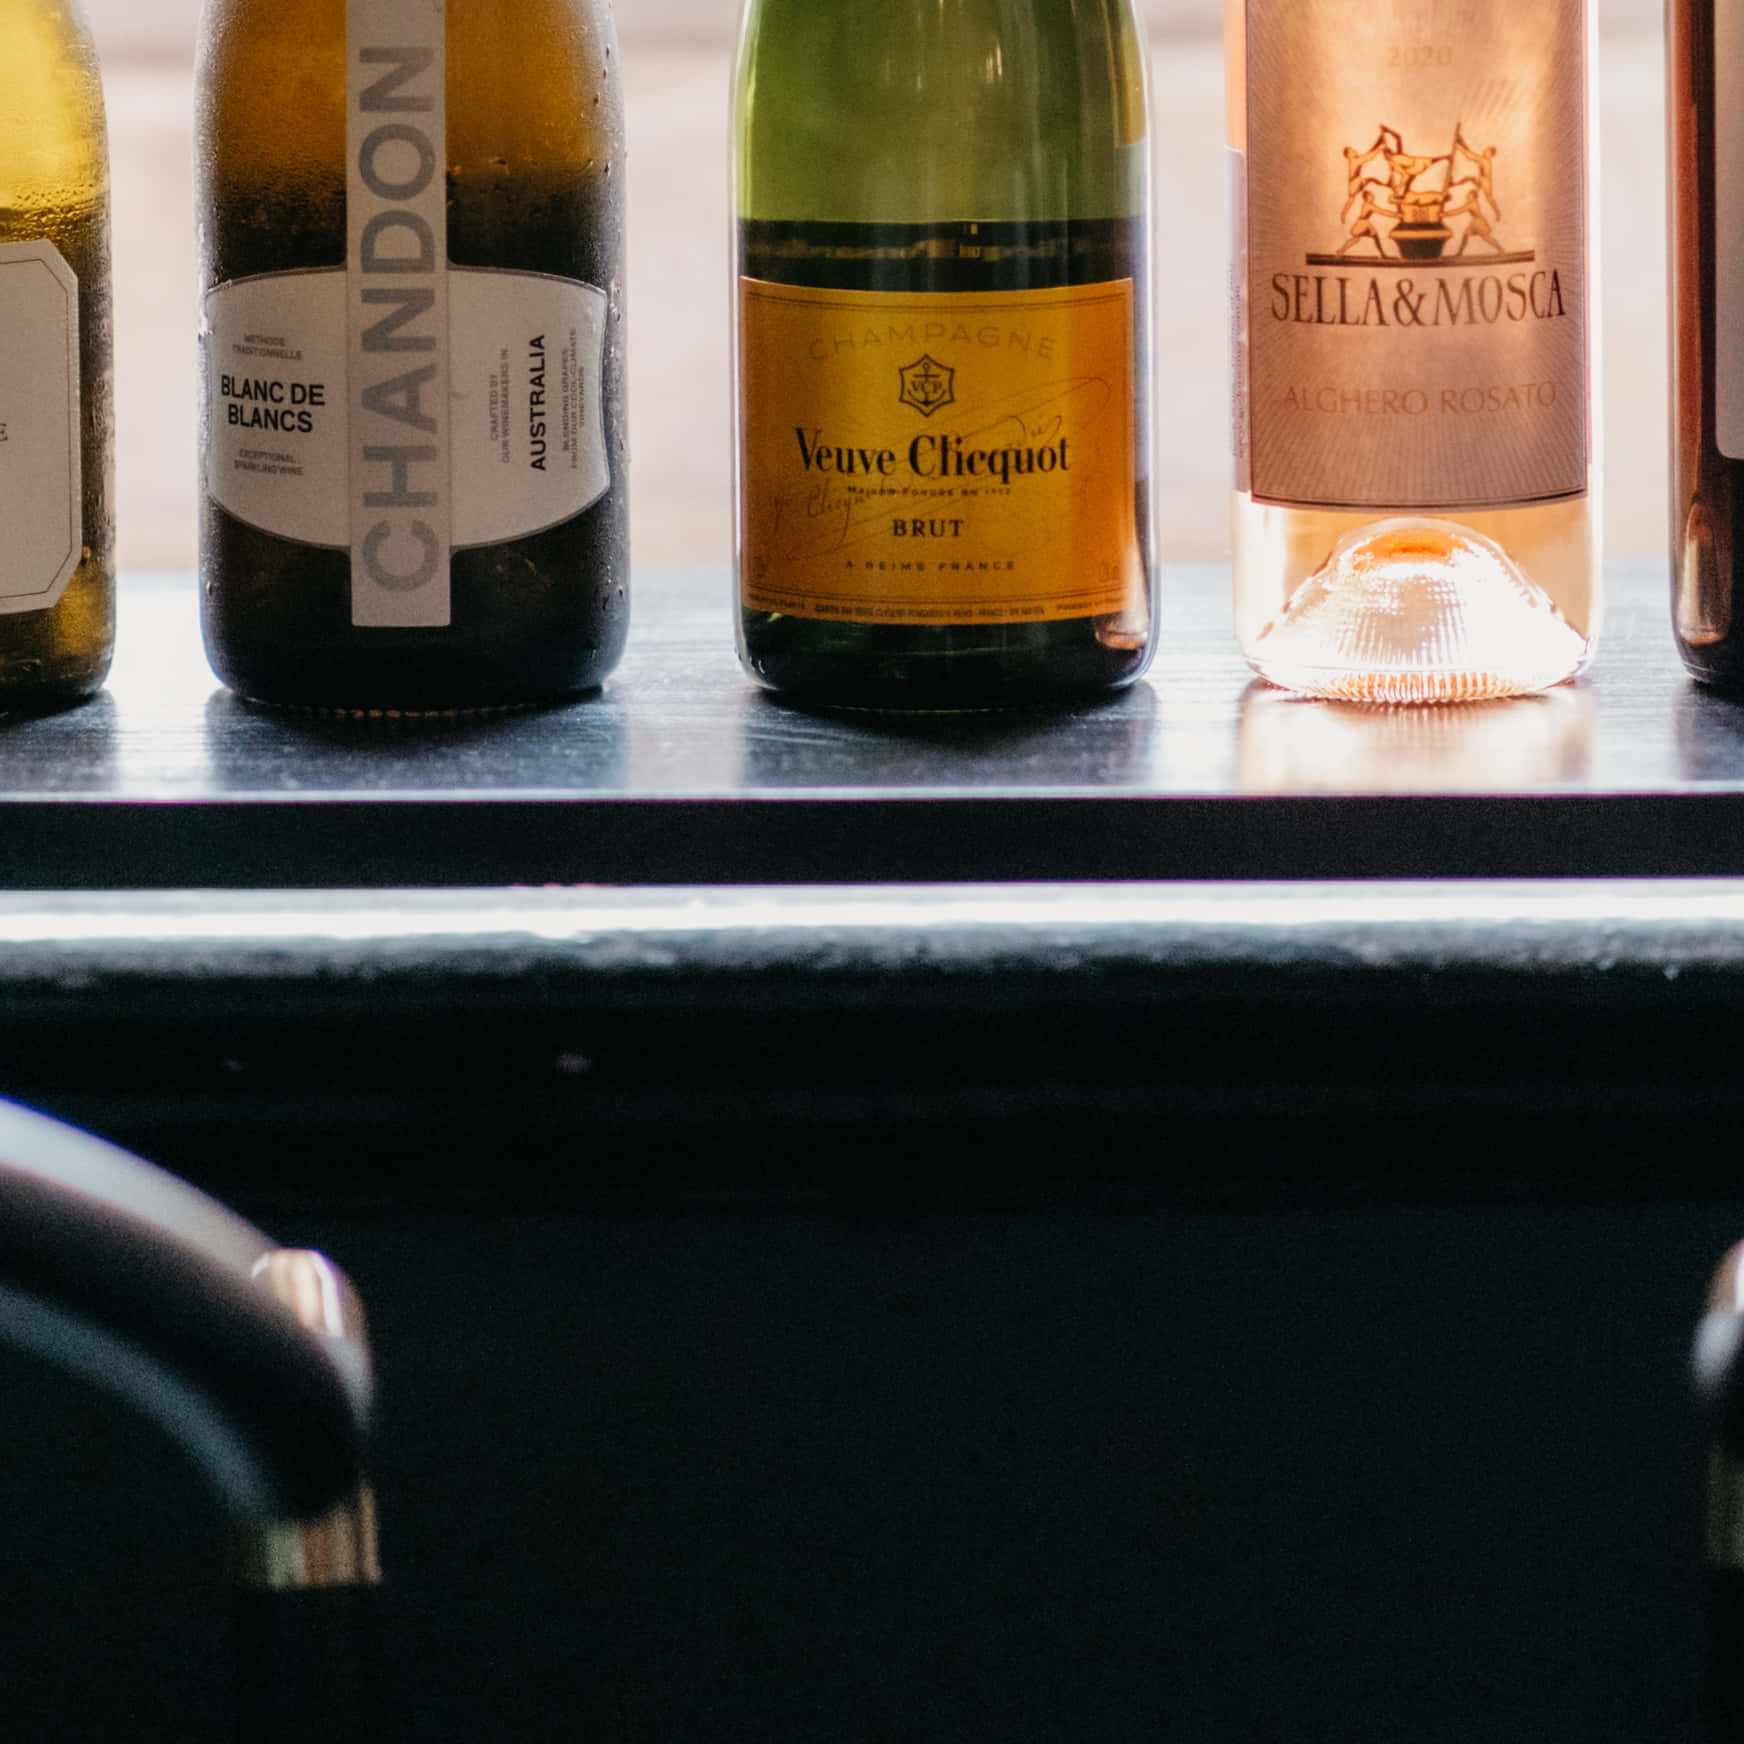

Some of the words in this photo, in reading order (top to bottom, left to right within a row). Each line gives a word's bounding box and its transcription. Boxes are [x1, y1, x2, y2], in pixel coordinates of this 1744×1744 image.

[358, 47, 441, 593] CHANDON
[808, 322, 1056, 362] CHAMPAGNE
[221, 374, 284, 404] BLANC
[291, 383, 325, 406] DE
[528, 334, 546, 471] AUSTRALIA
[1283, 384, 1429, 417] ALGHERO
[1441, 379, 1557, 414] ROSATO
[228, 403, 313, 433] BLANCS
[794, 426, 896, 477] Veuve
[908, 434, 1071, 485] Clicquot
[893, 519, 964, 537] BRUT
